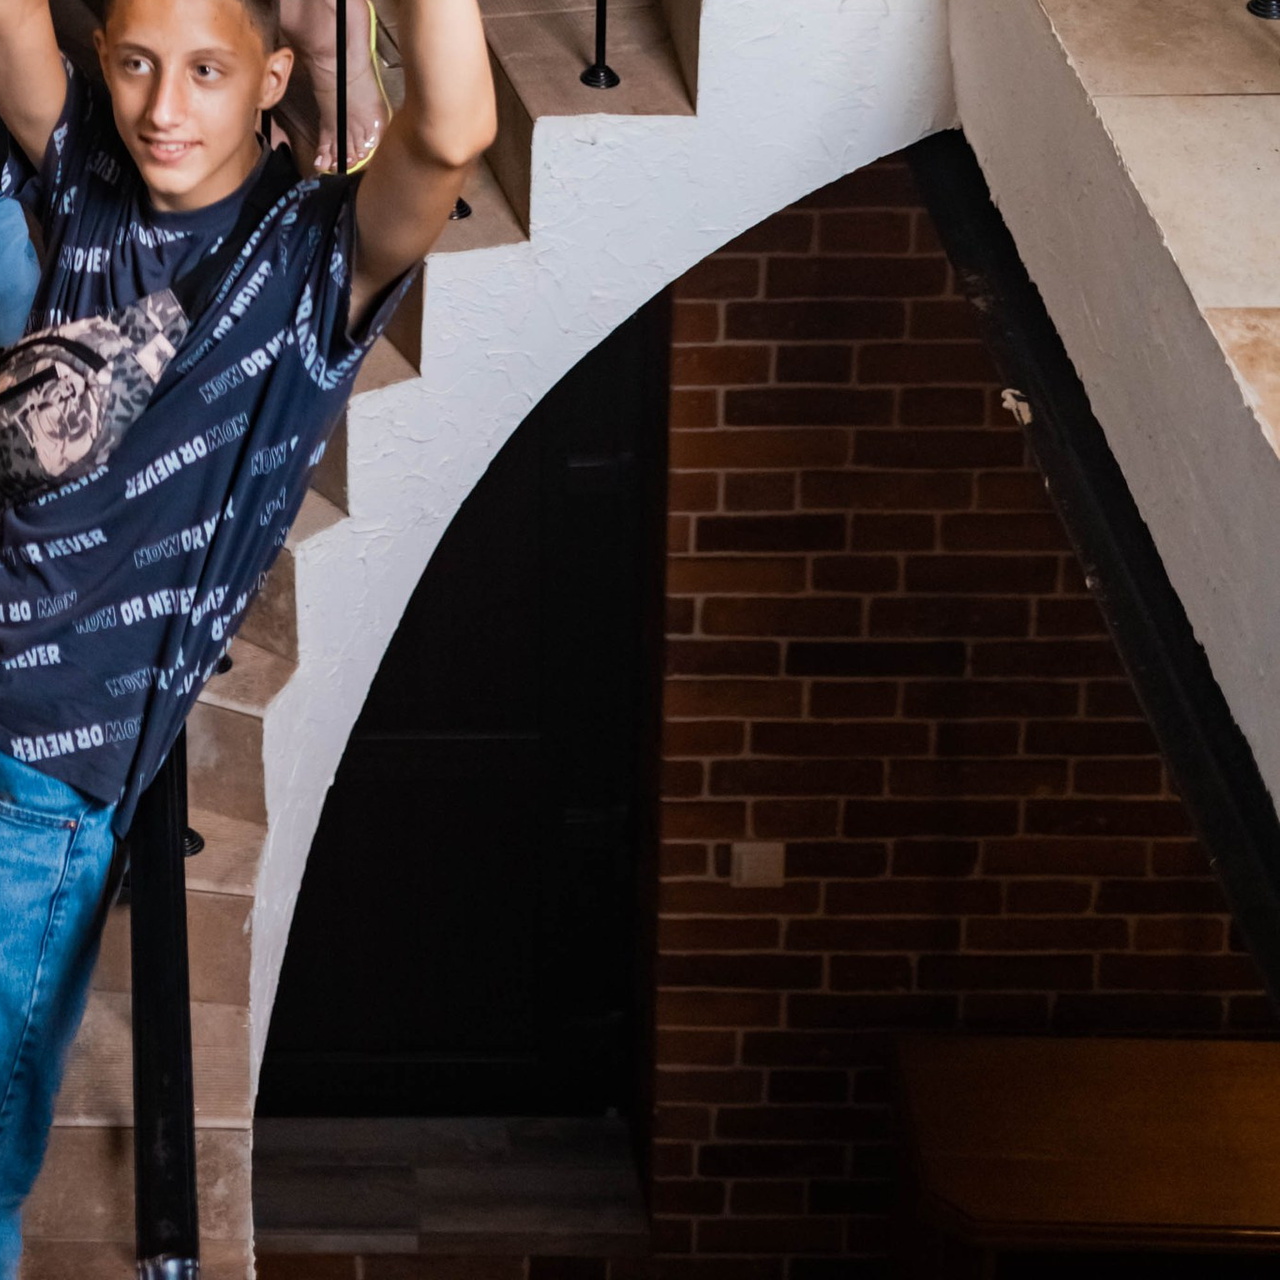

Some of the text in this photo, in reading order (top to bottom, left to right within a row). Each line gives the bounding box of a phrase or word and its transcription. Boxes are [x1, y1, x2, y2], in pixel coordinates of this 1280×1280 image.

[199, 363, 245, 404] NOW
[240, 346, 272, 378] OR
[124, 454, 183, 501] NEVER
[178, 435, 208, 466] OR
[44, 527, 109, 561] NEVER
[133, 525, 205, 569] NOW OR
[8, 599, 32, 623] OR
[120, 595, 147, 626] OR
[9, 731, 76, 763] NEVER
[74, 723, 105, 751] OR
